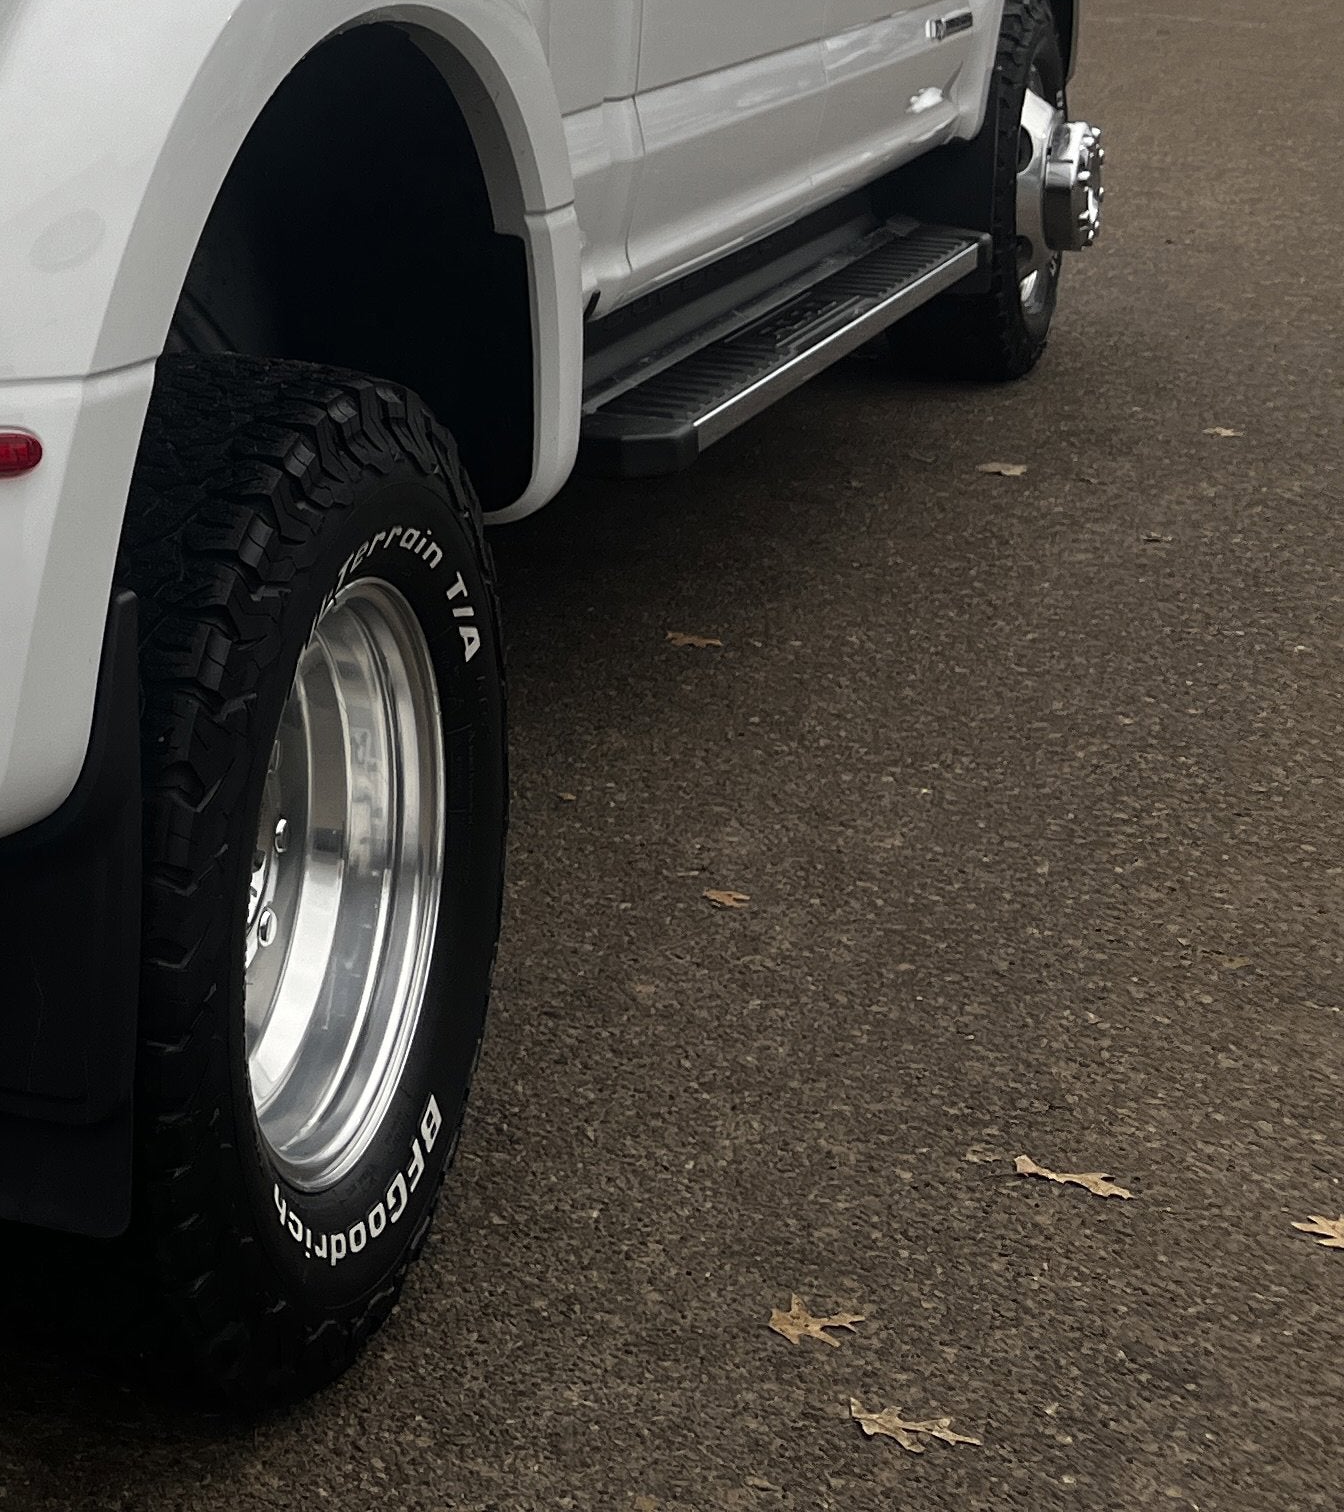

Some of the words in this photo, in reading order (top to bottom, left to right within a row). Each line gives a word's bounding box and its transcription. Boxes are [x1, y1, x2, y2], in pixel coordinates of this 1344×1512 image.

[335, 525, 444, 592] Terrain
[446, 571, 481, 663] T/A
[274, 1094, 443, 1266] BFGoodrich
